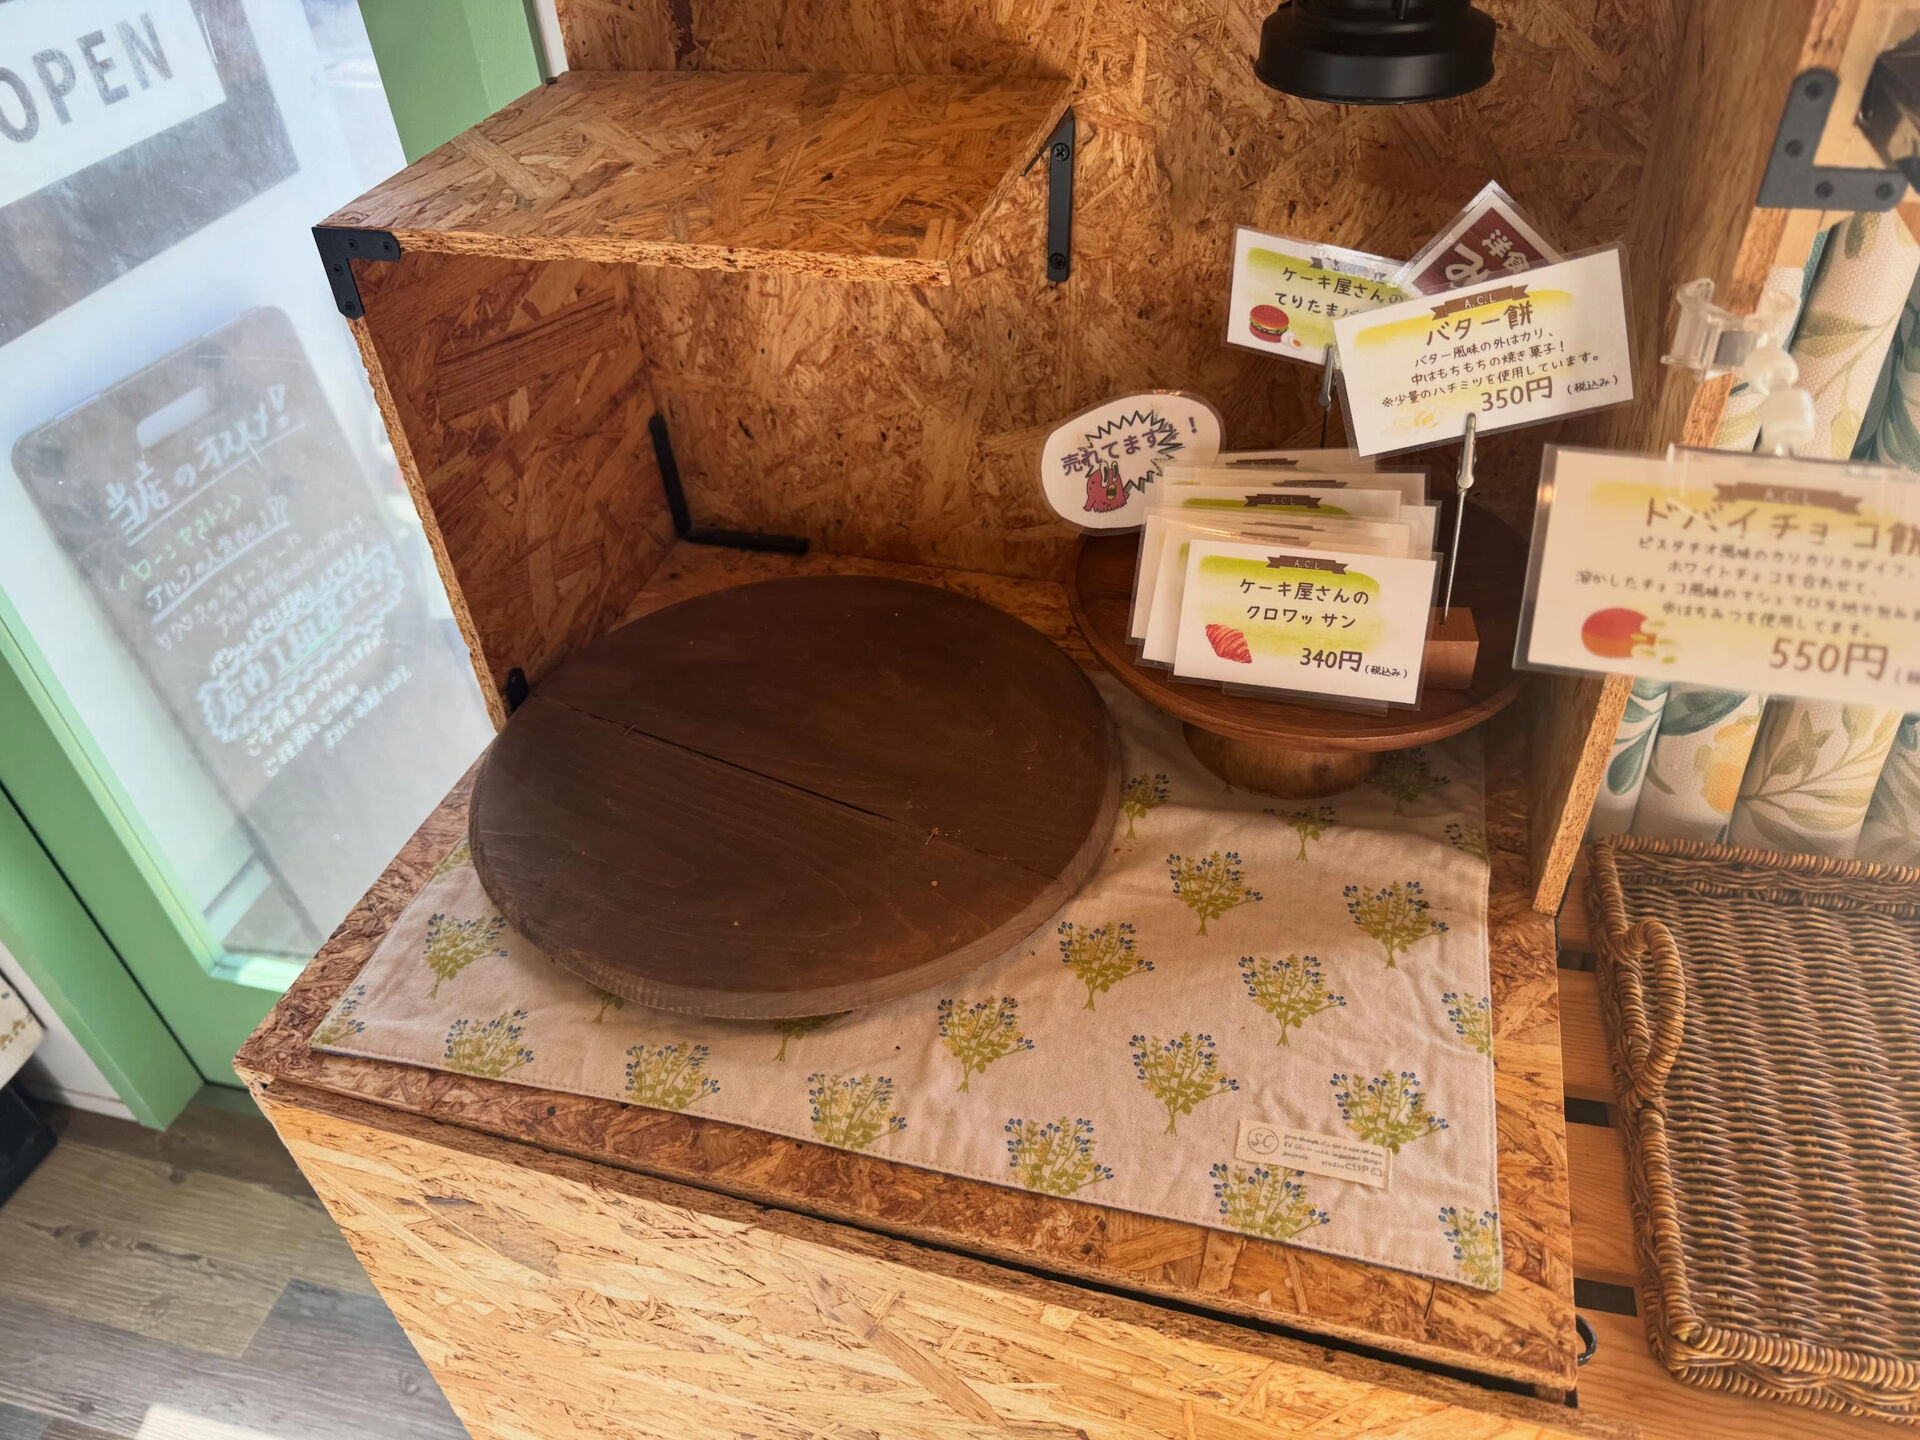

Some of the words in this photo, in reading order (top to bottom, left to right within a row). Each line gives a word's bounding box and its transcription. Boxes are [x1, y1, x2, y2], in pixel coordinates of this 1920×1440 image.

[0, 13, 173, 143] OPEN
[1282, 266, 1404, 305] ケーキ屋さんの
[1426, 300, 1533, 346] バター餅
[1480, 376, 1553, 412] 350円
[1239, 578, 1370, 606] ケーキ屋さんの
[1246, 606, 1357, 630] クロワッサン
[1299, 648, 1364, 672] 340円
[1364, 664, 1409, 679] (税込み)
[1768, 637, 1889, 682] 550円
